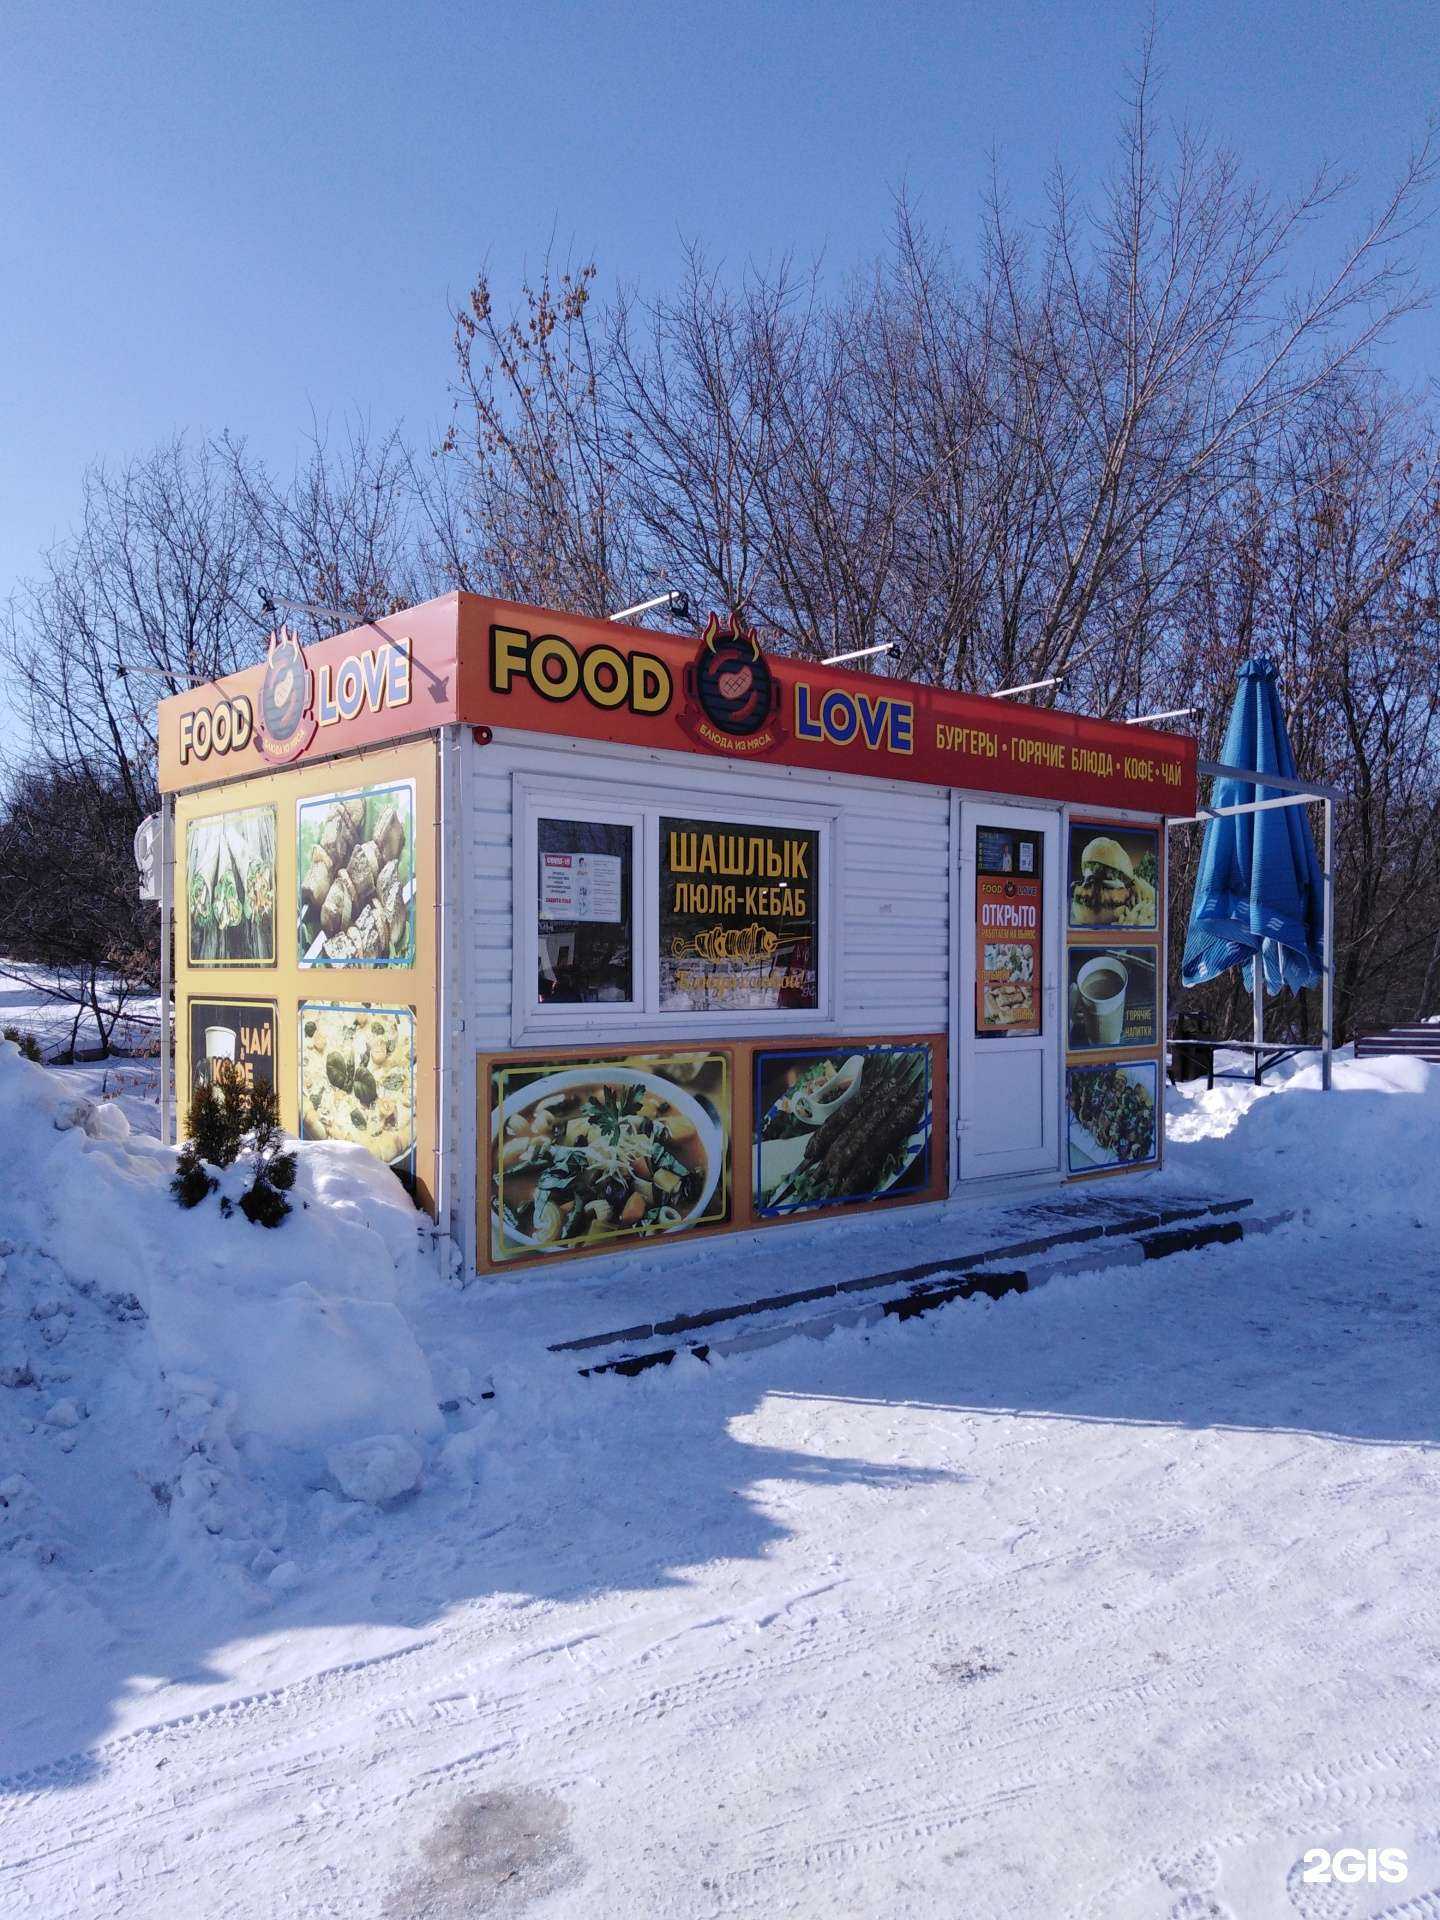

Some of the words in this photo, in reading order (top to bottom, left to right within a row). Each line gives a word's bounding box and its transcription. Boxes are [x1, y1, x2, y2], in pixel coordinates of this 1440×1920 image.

[319, 637, 412, 727] LOVE
[489, 624, 673, 716] FOOD
[180, 694, 253, 765] FOOD
[700, 724, 734, 750] БЛЮДА
[734, 740, 747, 751] ИЗ
[747, 733, 772, 750] МЯСА
[795, 682, 913, 755] LOVE
[936, 723, 998, 758] БУРГЕРЫ
[1011, 737, 1065, 769] ГОРЯЧИЕ
[1071, 748, 1113, 777] БЛЮДА
[1124, 756, 1154, 783] КОФЕ
[1161, 760, 1182, 787] ЧАЙ
[670, 831, 809, 879] ШАШЛЫК
[673, 882, 807, 918] ЛЮЛЯ-КЕБАБ
[982, 883, 1003, 896] FOOD
[982, 903, 1036, 928] ОТКРЫТО
[240, 1022, 271, 1057] ЧАЙ
